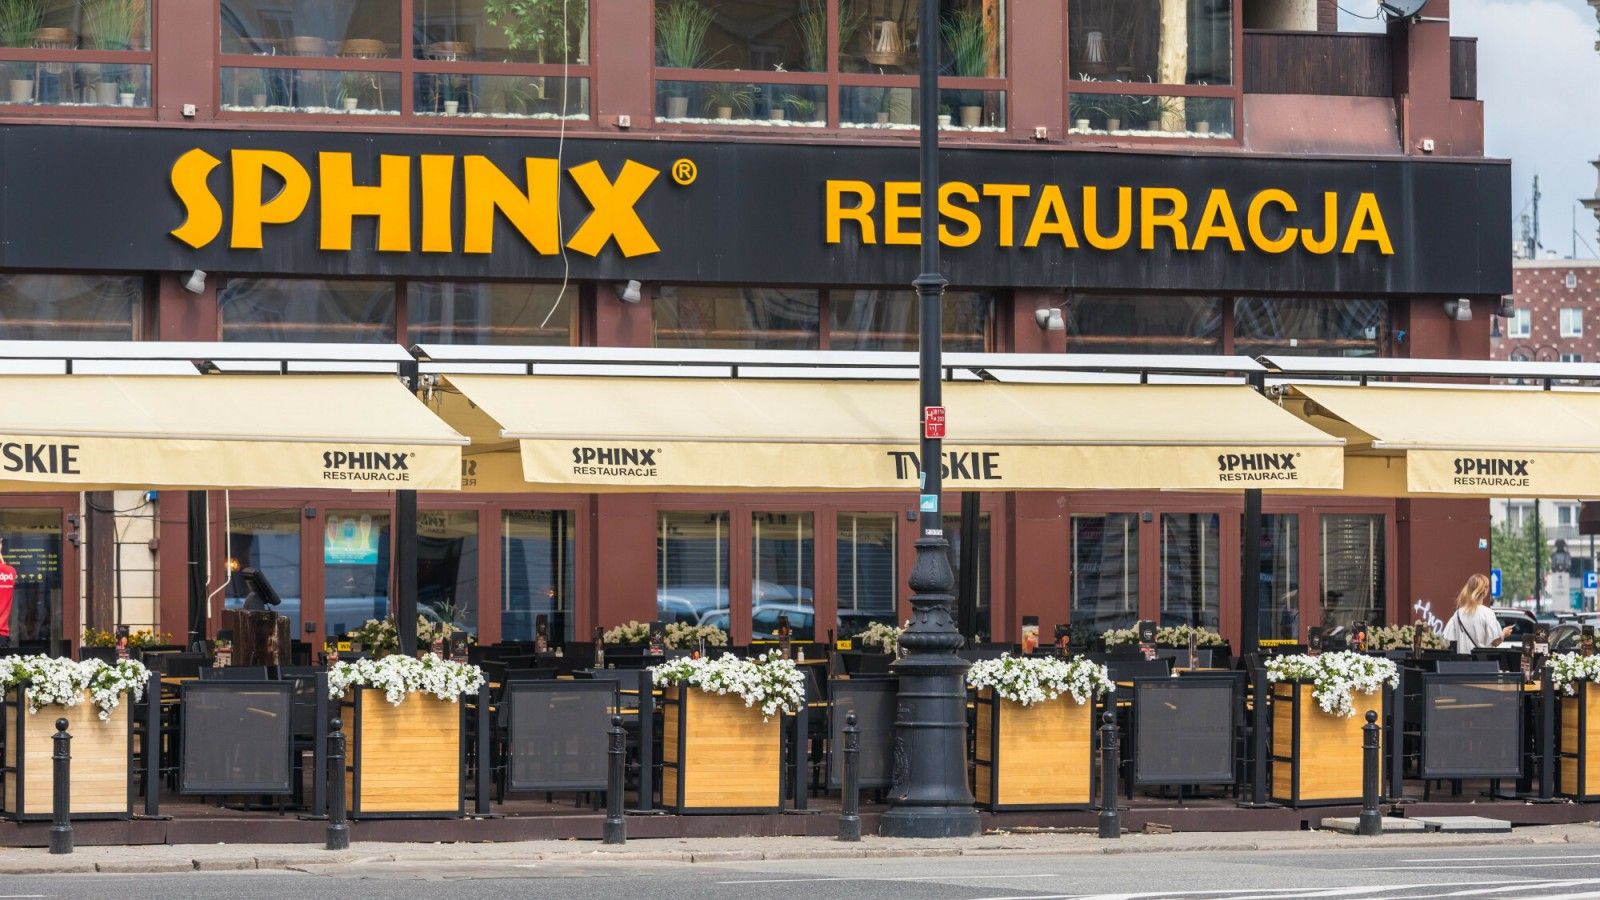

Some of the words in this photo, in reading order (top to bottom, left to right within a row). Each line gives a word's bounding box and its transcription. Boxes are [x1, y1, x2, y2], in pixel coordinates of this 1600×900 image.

[825, 179, 1394, 256] RESTAURACJA
[0, 442, 80, 475] SKIE
[323, 471, 409, 481] RESTAURACJE
[573, 466, 658, 477] RESTAURACJE
[1219, 469, 1298, 481] RESTAURACJE
[1454, 474, 1530, 487] RESTAURACJE
[1588, 573, 1598, 587] P
